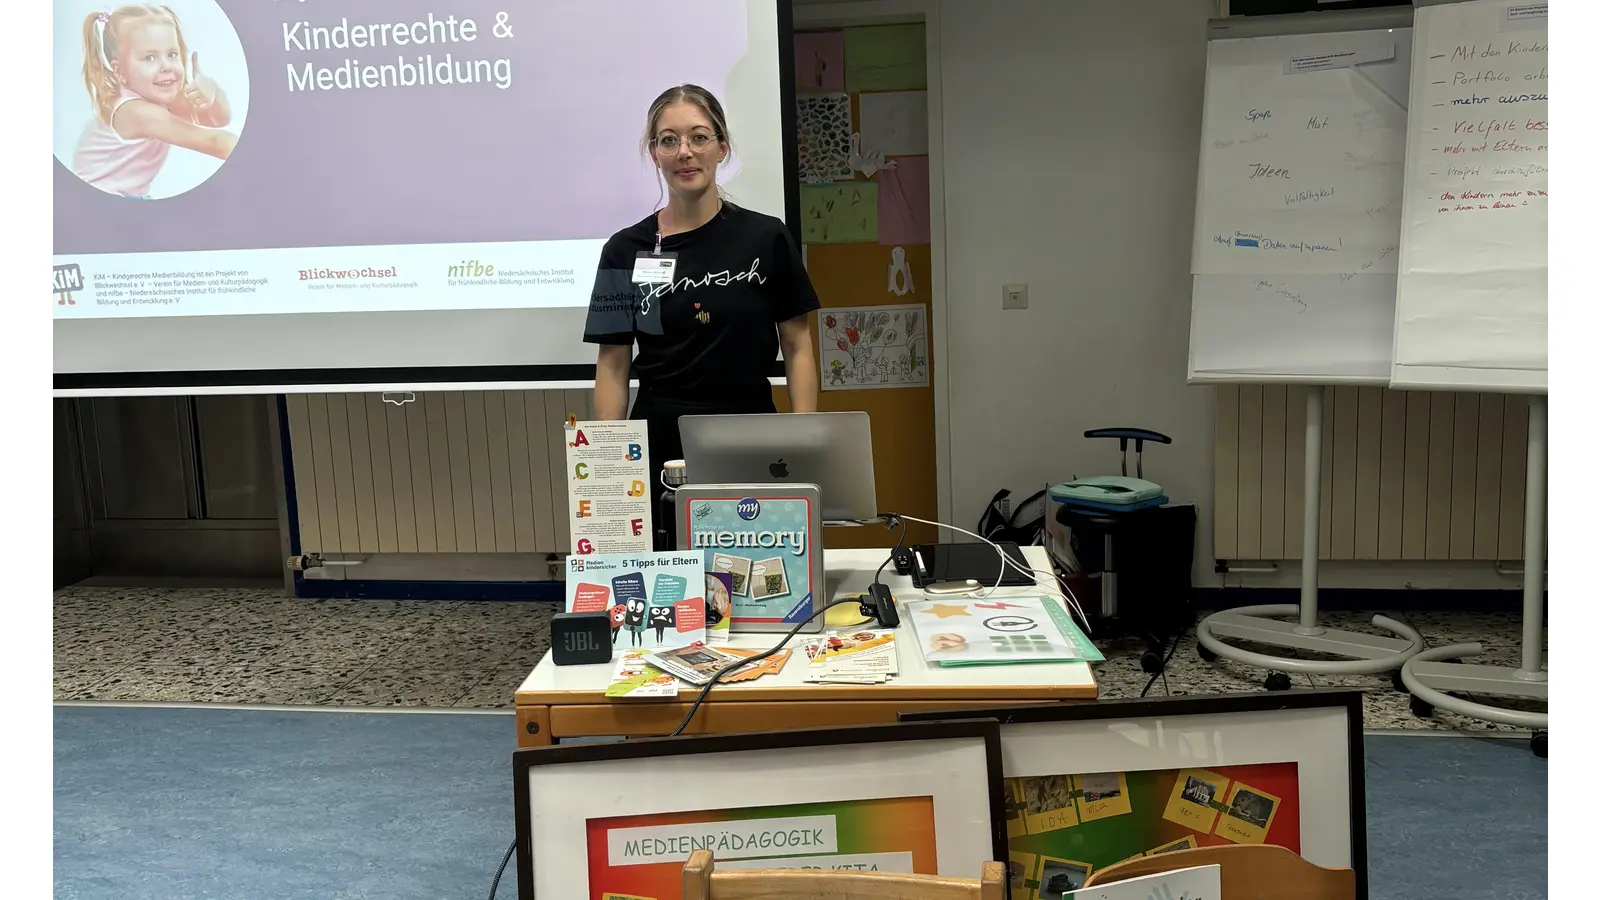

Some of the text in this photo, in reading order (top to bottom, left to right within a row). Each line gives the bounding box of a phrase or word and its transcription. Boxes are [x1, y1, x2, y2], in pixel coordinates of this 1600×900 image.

[282, 11, 514, 51] Kinderrechte &
[1451, 44, 1476, 62] Mit
[1481, 43, 1501, 58] den
[286, 53, 512, 92] Medienbildung
[1453, 67, 1548, 85] Portfolio arb
[1451, 93, 1490, 105] mehr
[1306, 116, 1329, 130] Mut
[1453, 119, 1516, 139] Vielfalt
[1493, 138, 1532, 152] Eltern
[112, 272, 150, 281] Kindgerechte
[152, 271, 195, 279] Medienbildung
[215, 270, 236, 278] Projekt
[298, 266, 397, 281] Blickwechsel
[448, 259, 494, 277] nifbe
[498, 269, 550, 277] Niedersächsisches
[95, 281, 133, 289] Blickwechsel
[220, 277, 269, 286] Kulturpädagogik
[498, 278, 522, 286] Bildung
[523, 277, 536, 285] und
[537, 276, 575, 285] Entwicklung
[108, 289, 123, 297] nifbe
[130, 288, 185, 296] Niedersächsisches
[186, 287, 207, 295] Institut
[217, 286, 256, 294] frühkindliche
[132, 297, 168, 305] Entwicklung
[575, 429, 590, 447] A
[628, 444, 642, 460] B
[575, 462, 589, 479] C
[631, 480, 645, 497] D
[579, 500, 592, 518] E
[738, 502, 758, 519] my
[631, 518, 643, 536] F
[577, 538, 592, 555] G
[694, 529, 805, 556] memory
[622, 556, 698, 569] 5 Tipps für Eltern
[565, 630, 599, 652] JBL
[624, 828, 825, 857] MEDIENPÄDAGOGIK
